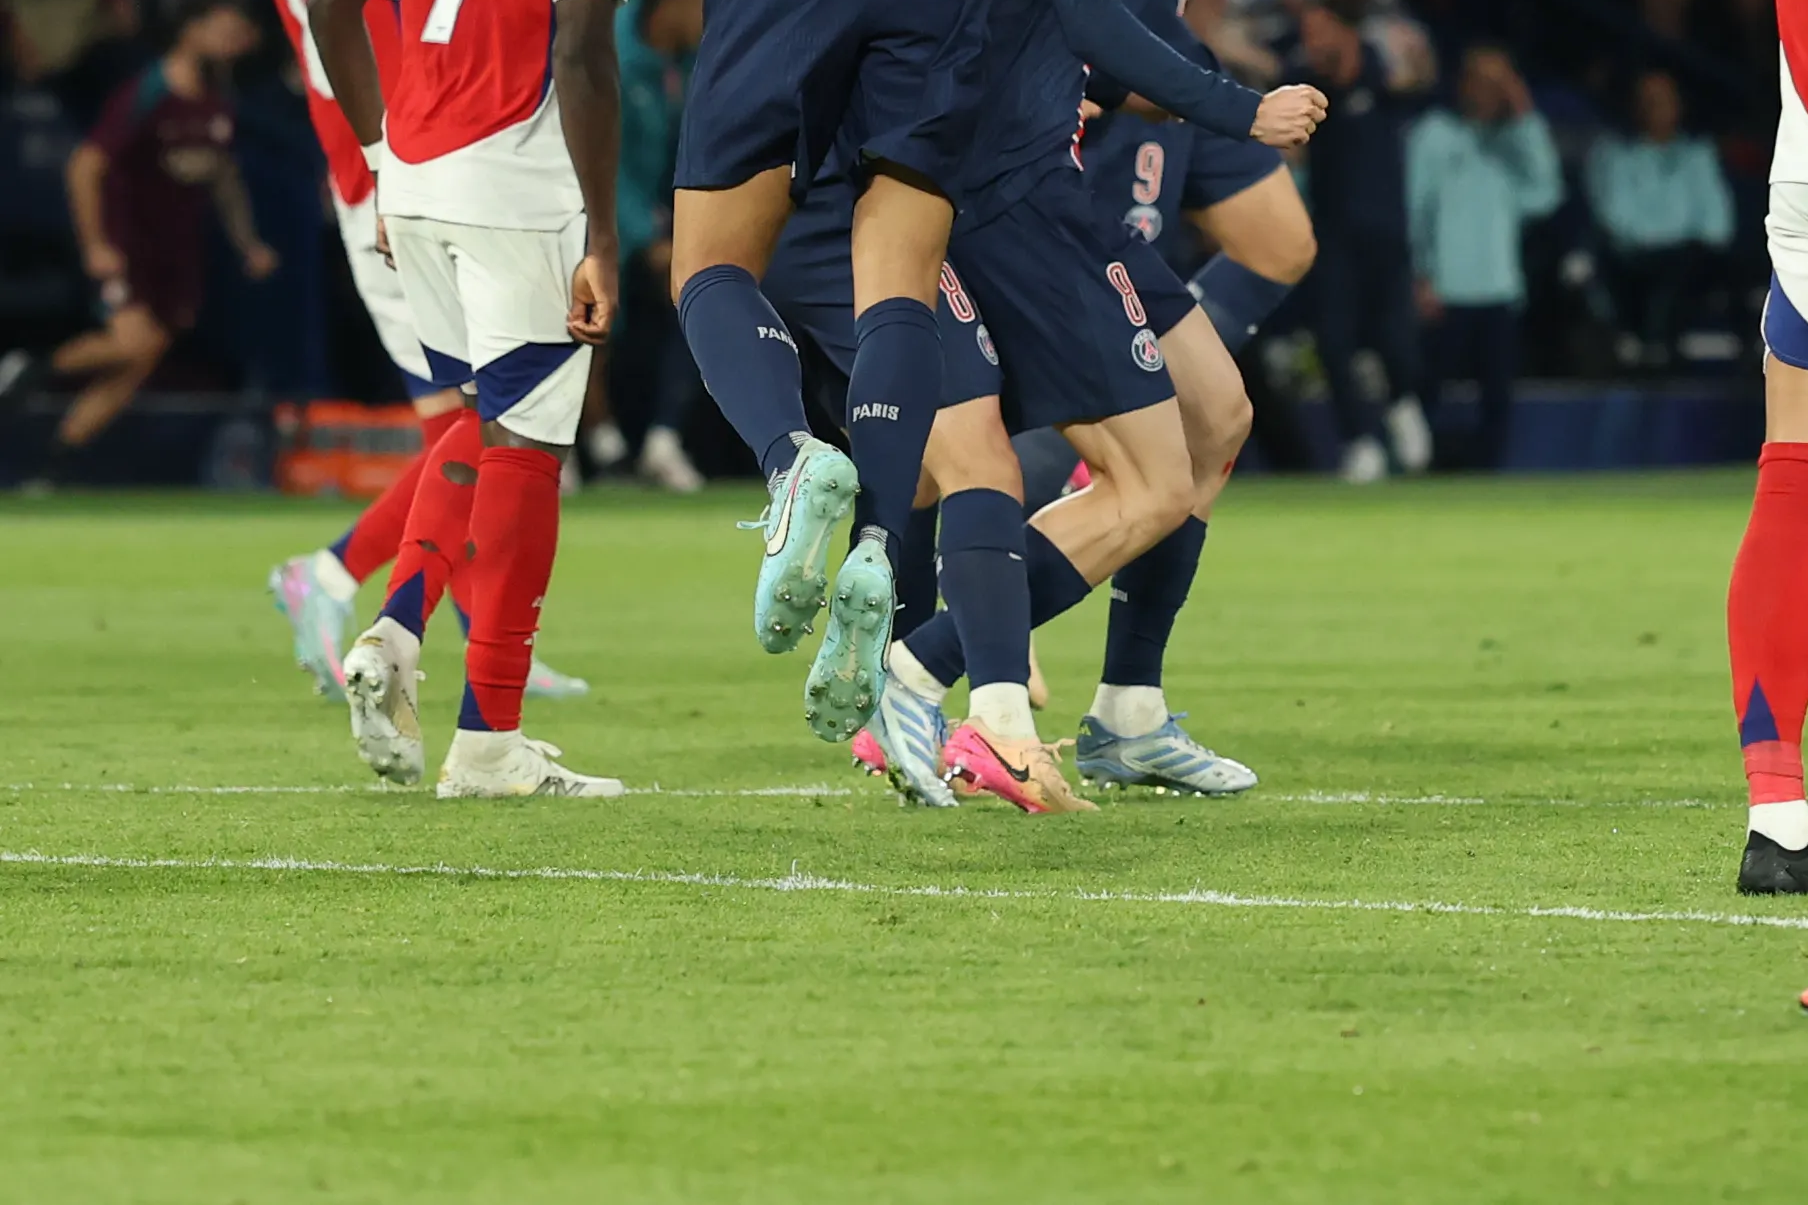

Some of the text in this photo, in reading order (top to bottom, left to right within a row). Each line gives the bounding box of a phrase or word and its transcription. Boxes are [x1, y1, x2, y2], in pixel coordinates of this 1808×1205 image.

[1132, 141, 1164, 205] 9
[939, 260, 976, 323] 8
[1106, 261, 1147, 327] 8
[852, 402, 900, 422] PARIS
